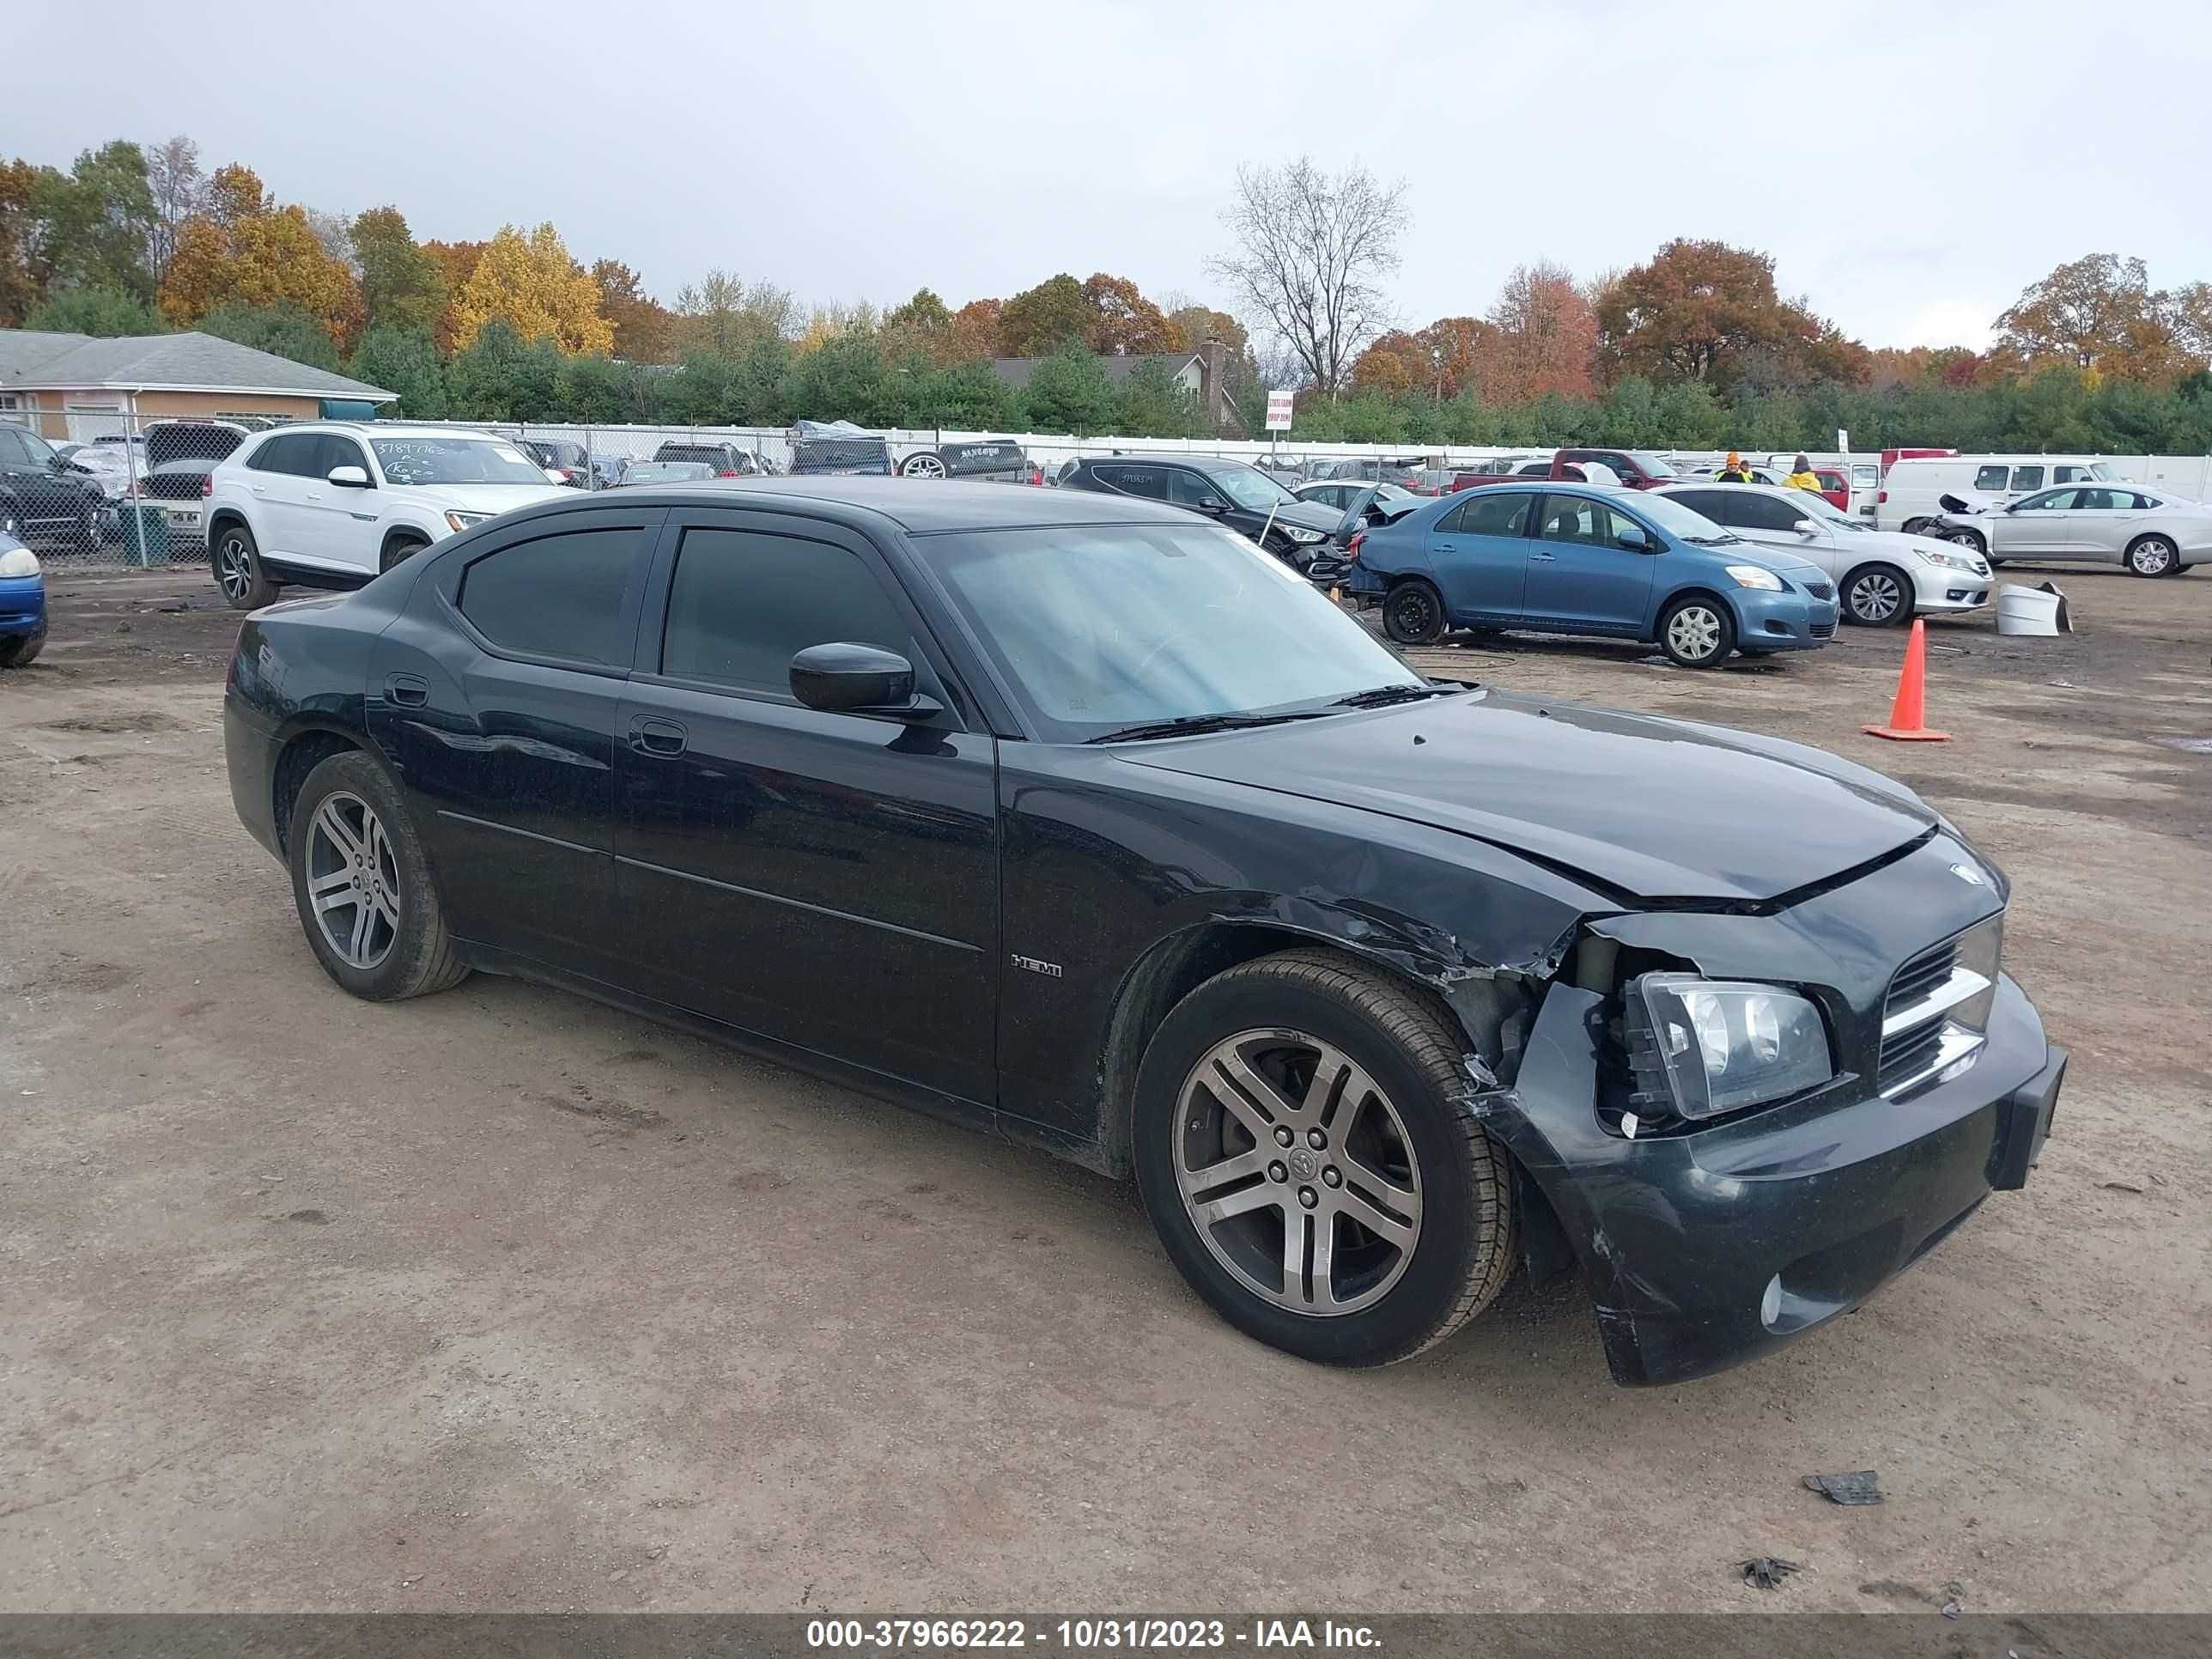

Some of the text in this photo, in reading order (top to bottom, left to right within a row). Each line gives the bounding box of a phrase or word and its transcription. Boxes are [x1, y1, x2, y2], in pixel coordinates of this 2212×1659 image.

[1269, 398, 1291, 407] STATE FARM
[1011, 953, 1062, 977] HEMI
